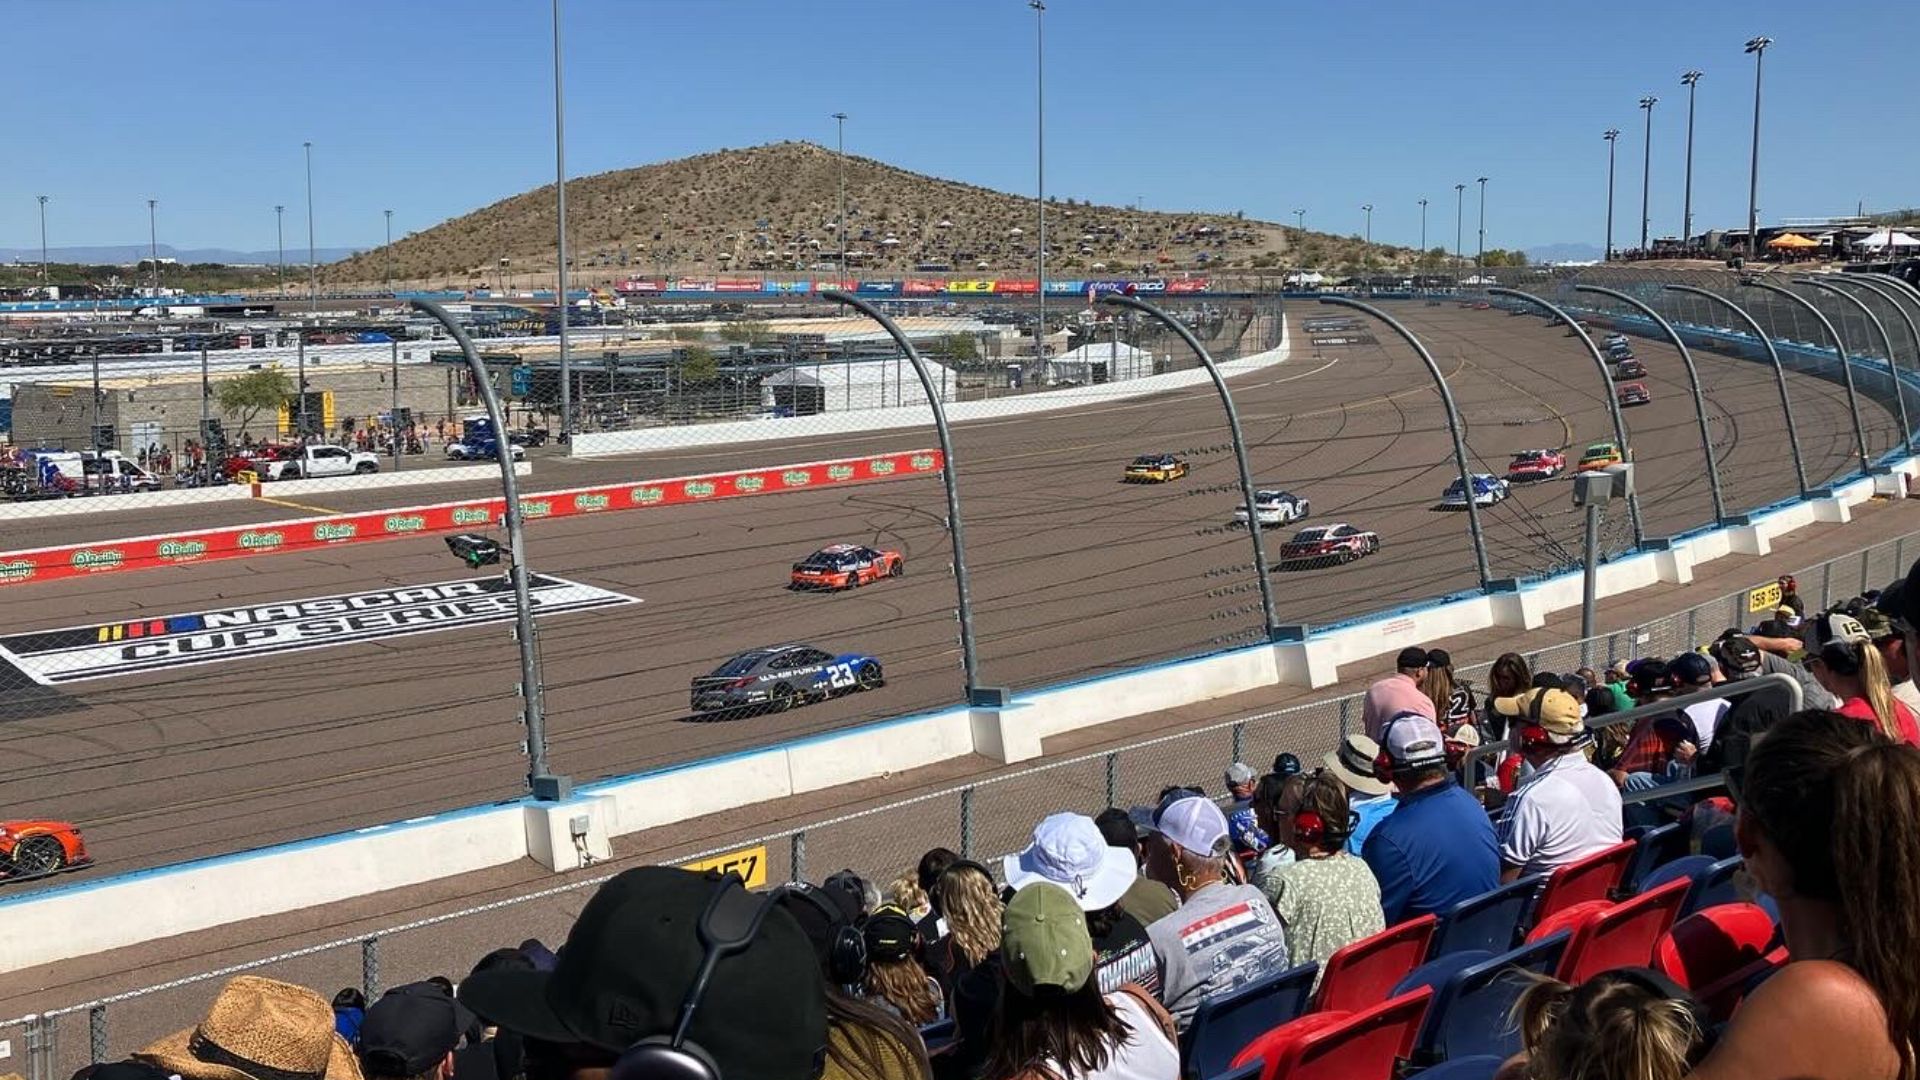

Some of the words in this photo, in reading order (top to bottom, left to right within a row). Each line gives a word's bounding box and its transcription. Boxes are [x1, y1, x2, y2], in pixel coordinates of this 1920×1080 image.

[315, 525, 355, 539] O'Reilly
[387, 517, 424, 531] O'Reilly
[240, 534, 282, 547] O'Reilly
[160, 541, 205, 558] O'Reilly
[203, 582, 486, 629] NASCAR
[121, 628, 278, 660] CUP
[298, 593, 543, 637] SERIES
[1842, 621, 1863, 635] 12
[827, 663, 856, 688] 23
[1446, 688, 1470, 719] 2
